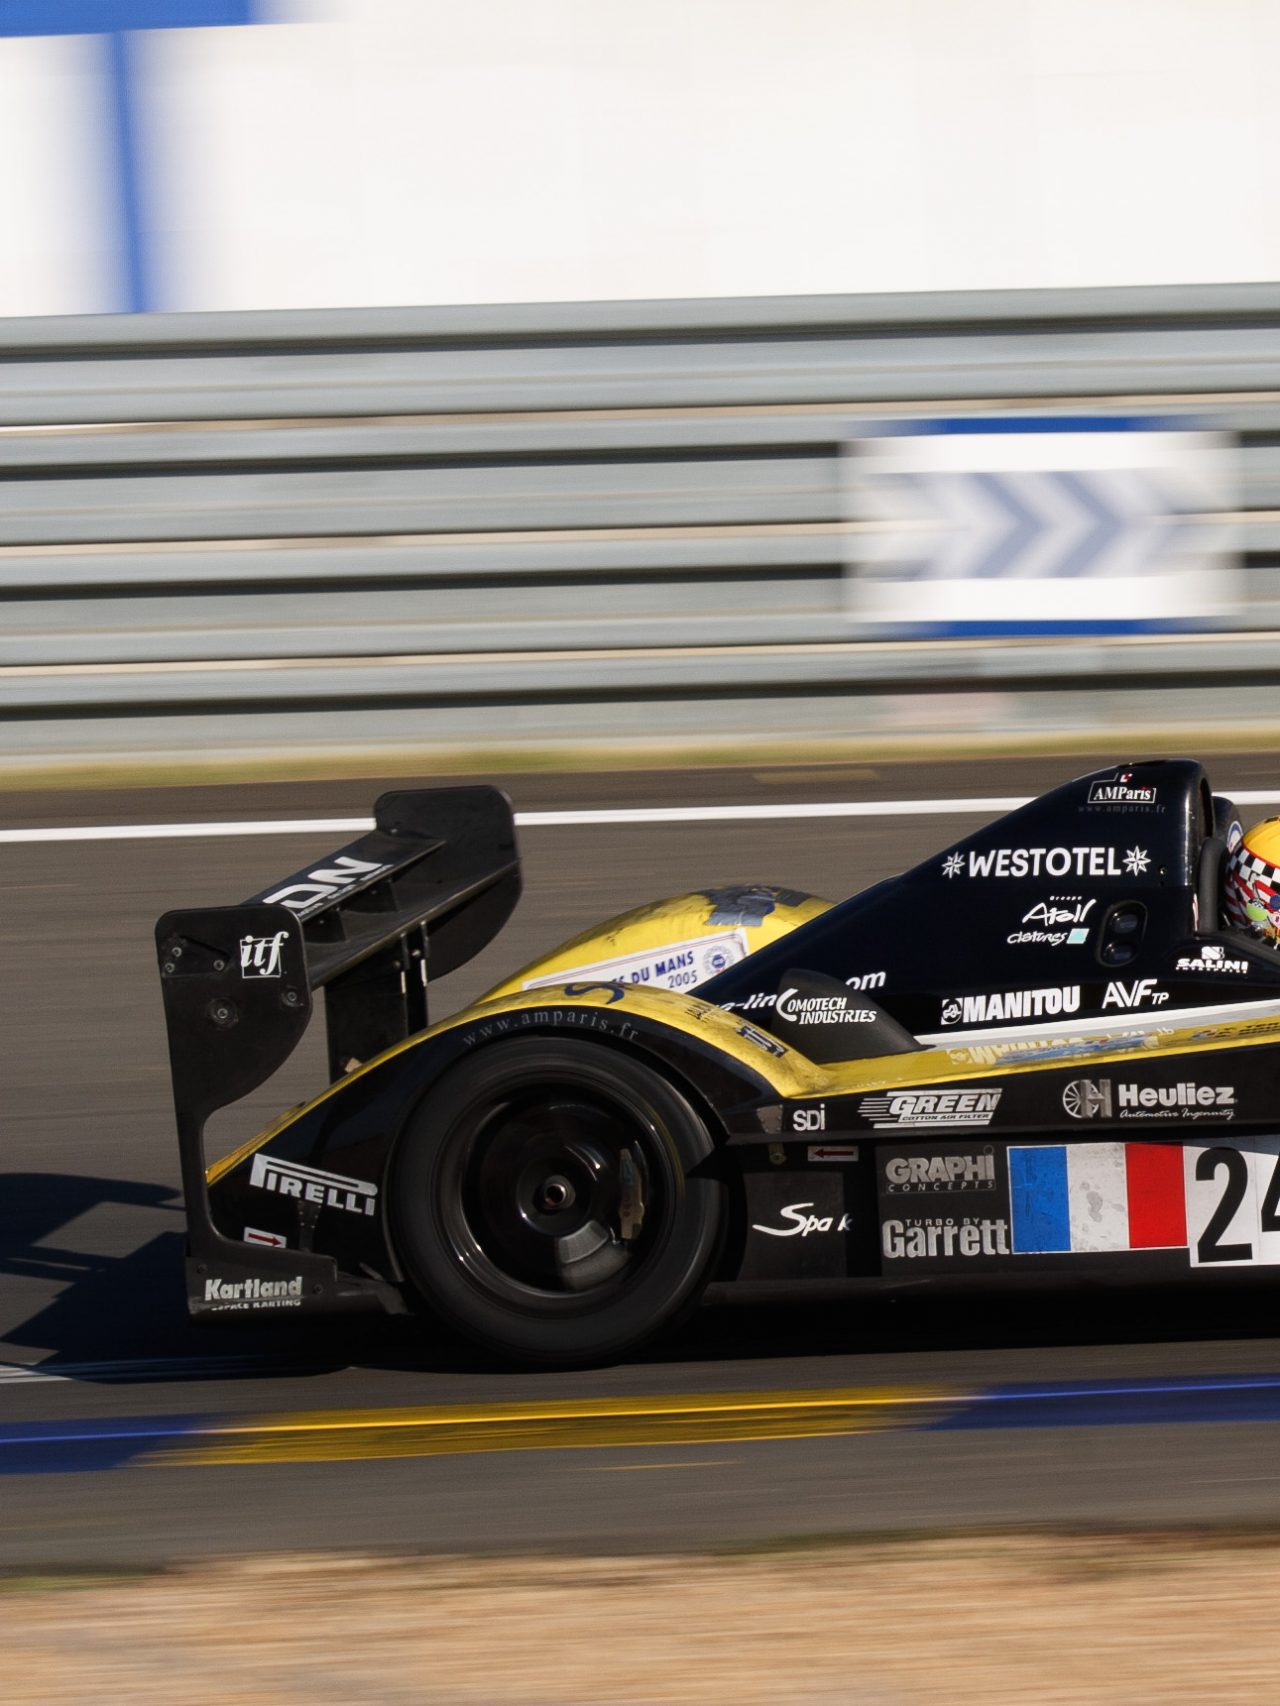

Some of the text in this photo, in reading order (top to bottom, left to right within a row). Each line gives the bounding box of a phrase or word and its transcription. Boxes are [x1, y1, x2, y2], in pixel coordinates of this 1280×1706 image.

[1093, 785, 1151, 800] AMParis
[968, 847, 1122, 877] WESTOTEL
[240, 931, 289, 976] itf
[1178, 958, 1249, 970] SALINI
[632, 967, 650, 984] DU
[655, 951, 694, 977] MANS
[668, 970, 698, 988] 2005
[776, 988, 847, 1021] COMOTECH
[962, 985, 1081, 1023] MANITOU
[1102, 979, 1169, 1009] AVF TP
[464, 1010, 639, 1047] www.amparis.fr
[799, 1010, 877, 1024] INDUSTRIES
[889, 1094, 1001, 1115] GREEN
[1118, 1083, 1235, 1107] Heuliez
[250, 1153, 378, 1216] PIRELLI
[888, 1181, 993, 1192] CONCEPTS
[905, 1218, 954, 1227] TURBO
[882, 1219, 1010, 1258] Garrett
[205, 1276, 302, 1301] Kartland
